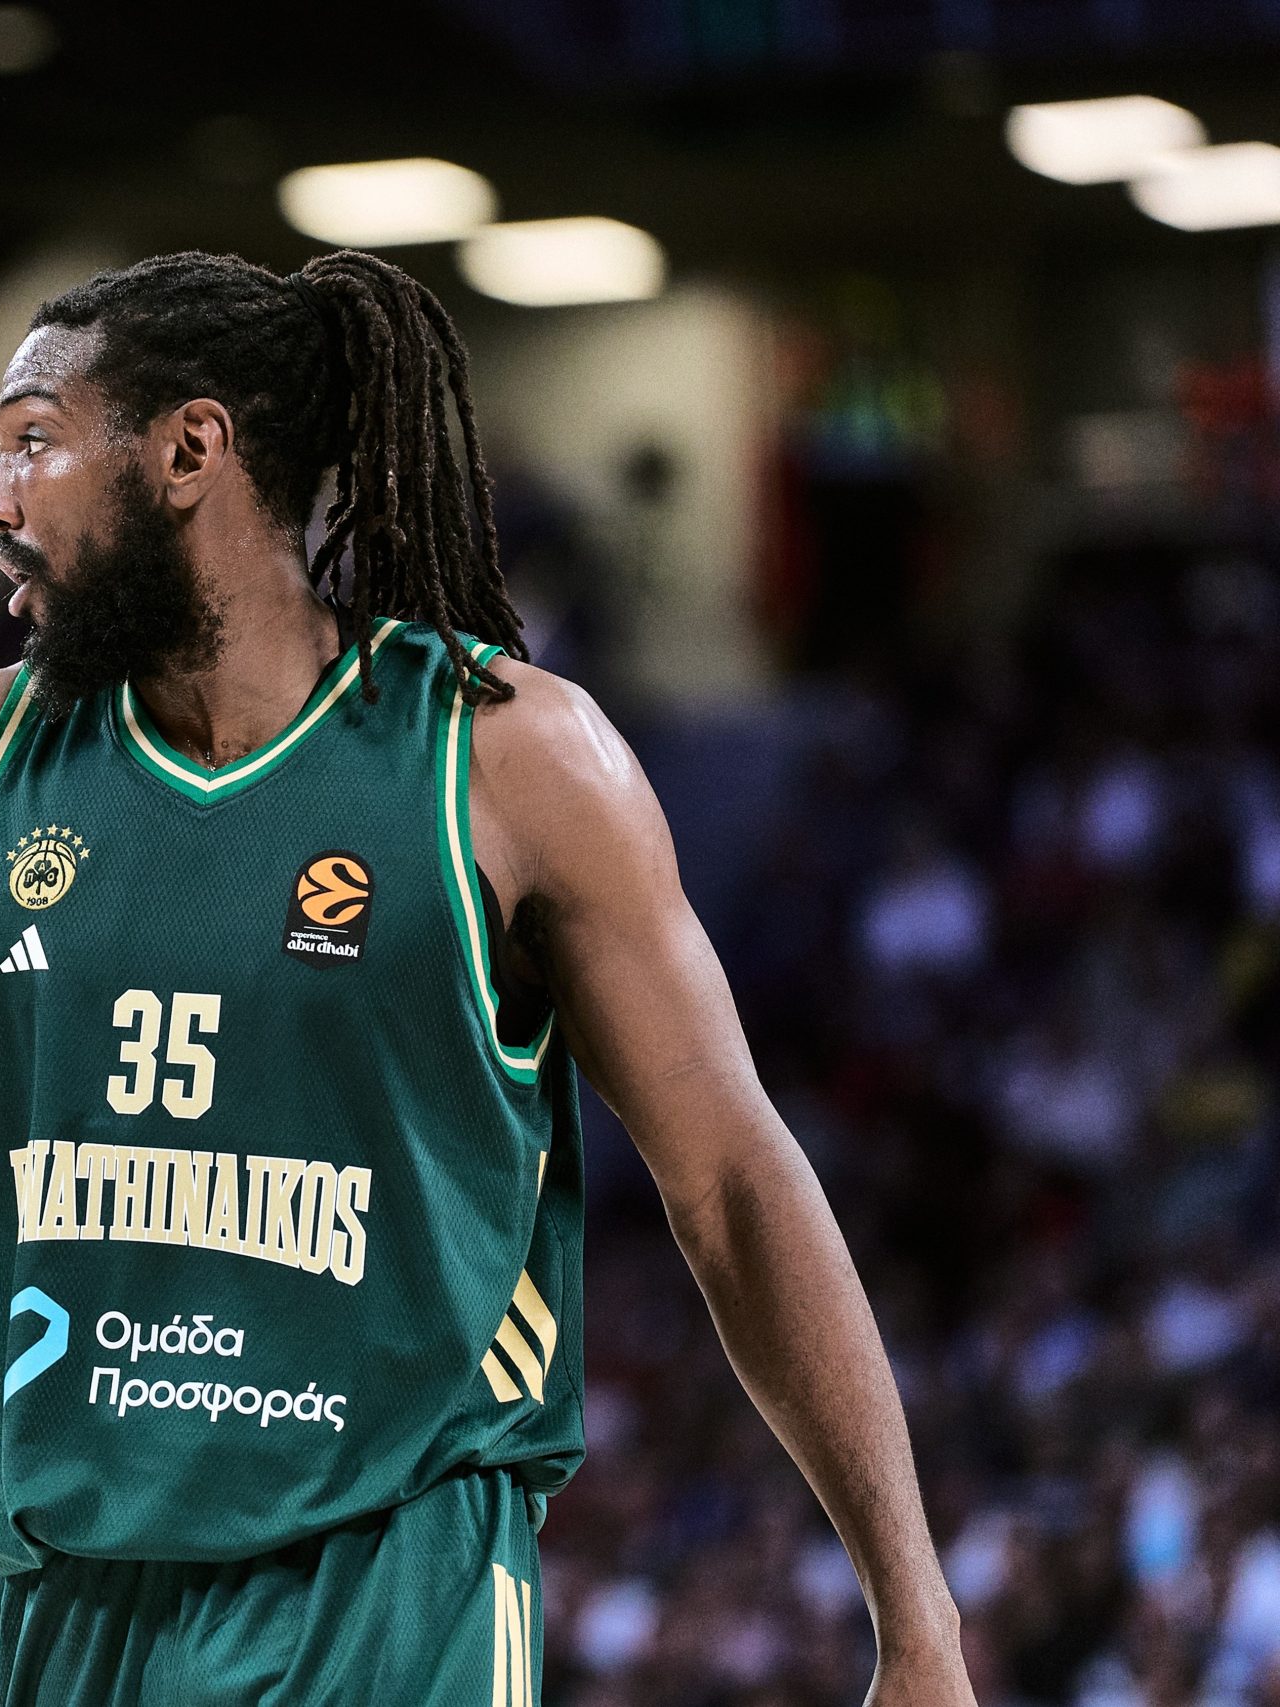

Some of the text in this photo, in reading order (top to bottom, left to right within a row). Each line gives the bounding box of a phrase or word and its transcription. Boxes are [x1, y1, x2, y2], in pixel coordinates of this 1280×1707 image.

[26, 896, 49, 907] 1908
[286, 938, 360, 958] abu dhabi
[290, 931, 329, 941] experience
[106, 989, 222, 1120] 35
[95, 1310, 245, 1362] Ομάδα
[88, 1366, 348, 1433] Προσφοράς
